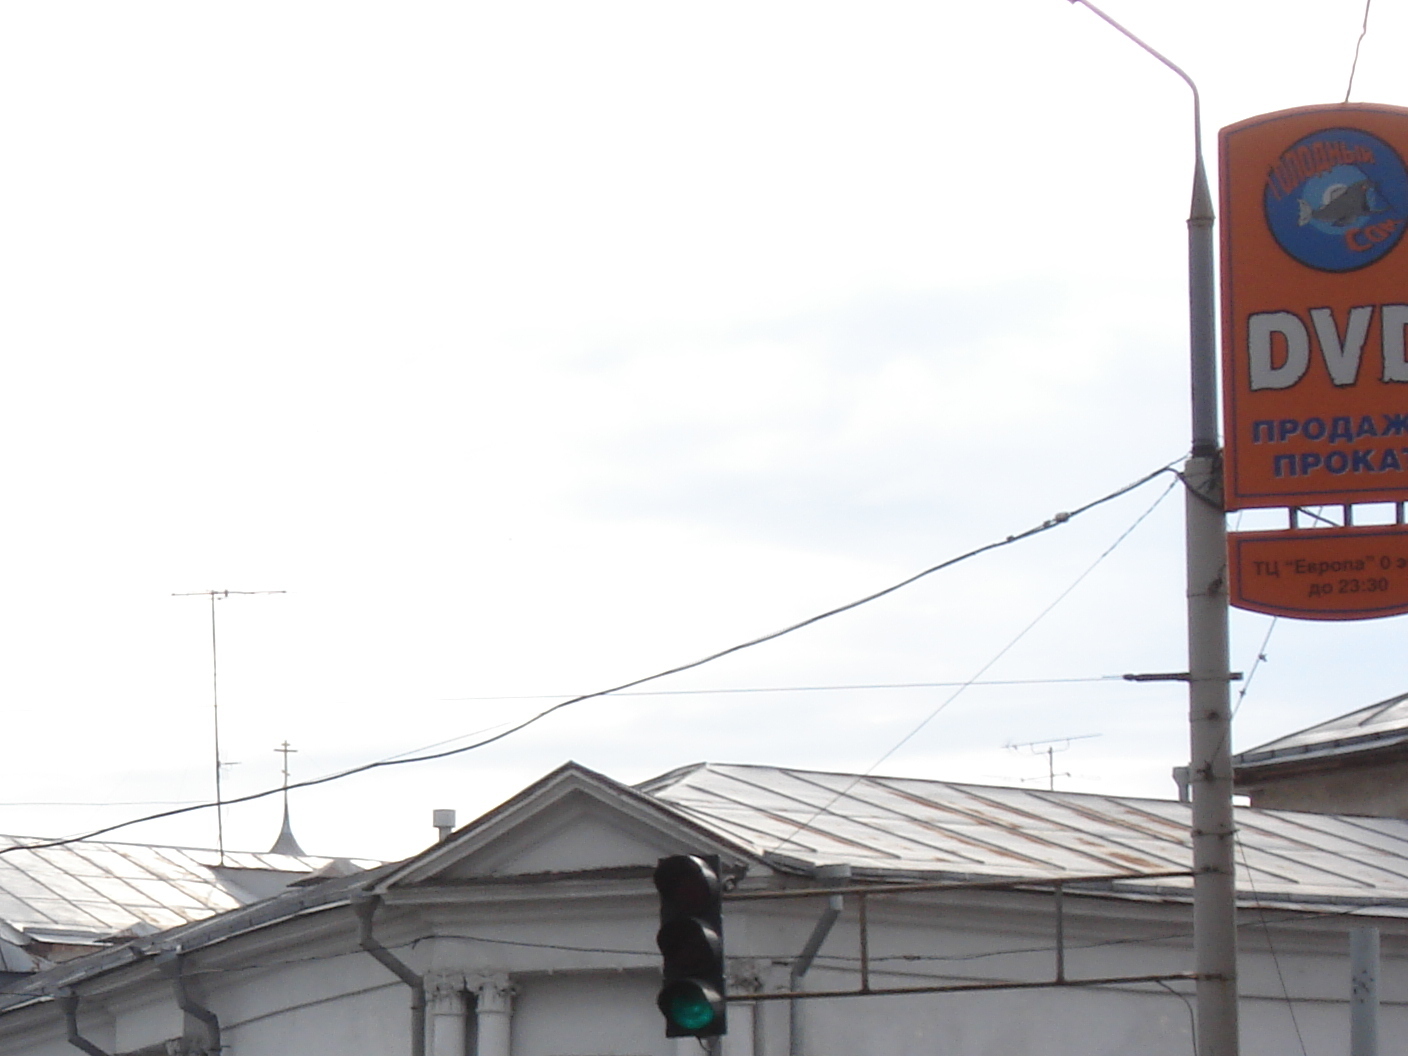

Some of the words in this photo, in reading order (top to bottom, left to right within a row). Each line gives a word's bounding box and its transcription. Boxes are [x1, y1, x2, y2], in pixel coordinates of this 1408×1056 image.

[1254, 560, 1280, 577] ТЦ
[1309, 583, 1333, 598] до
[1339, 577, 1389, 594] 23:30
